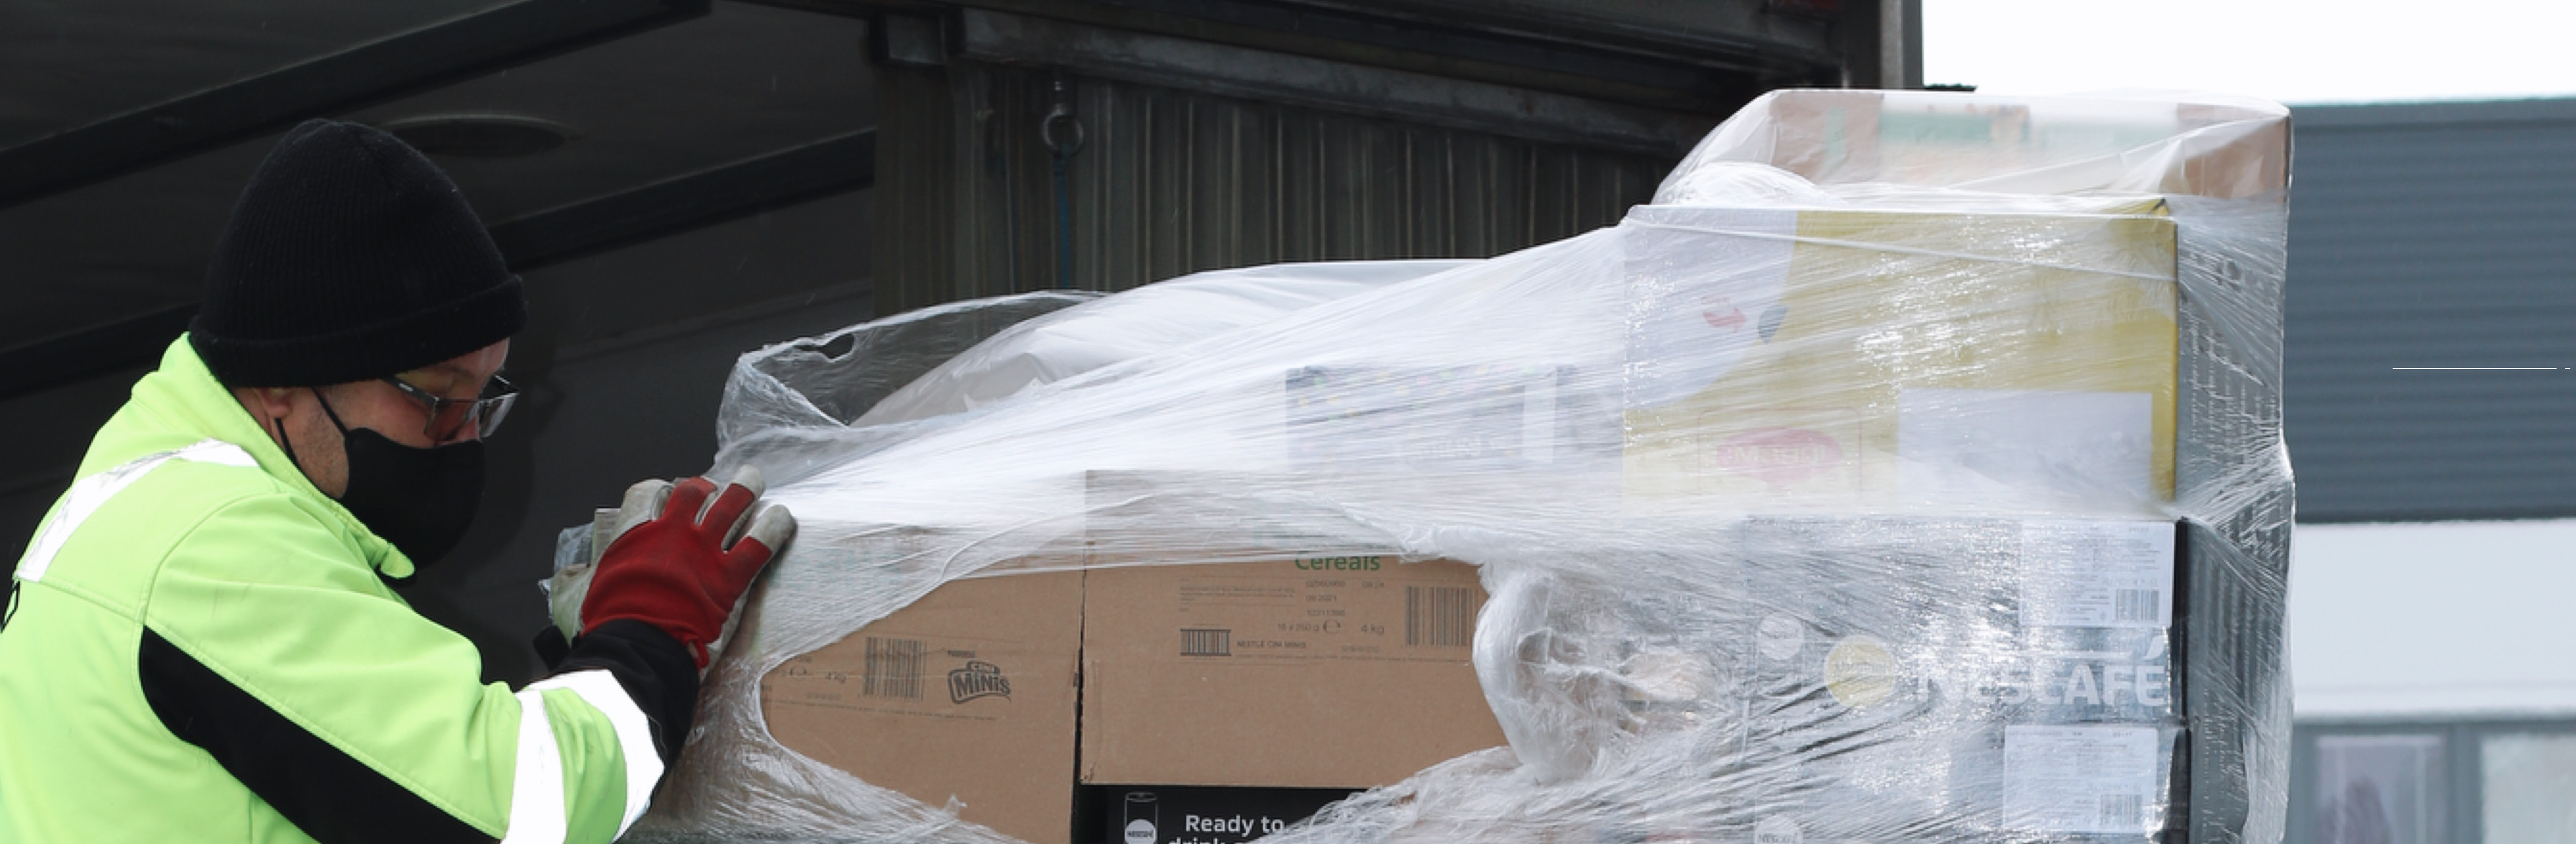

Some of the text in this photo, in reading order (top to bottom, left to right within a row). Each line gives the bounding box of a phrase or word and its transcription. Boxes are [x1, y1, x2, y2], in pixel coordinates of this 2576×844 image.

[1295, 556, 1380, 570] Cereals
[1361, 624, 1385, 636] 4 kg
[1186, 815, 1284, 837] Ready to
